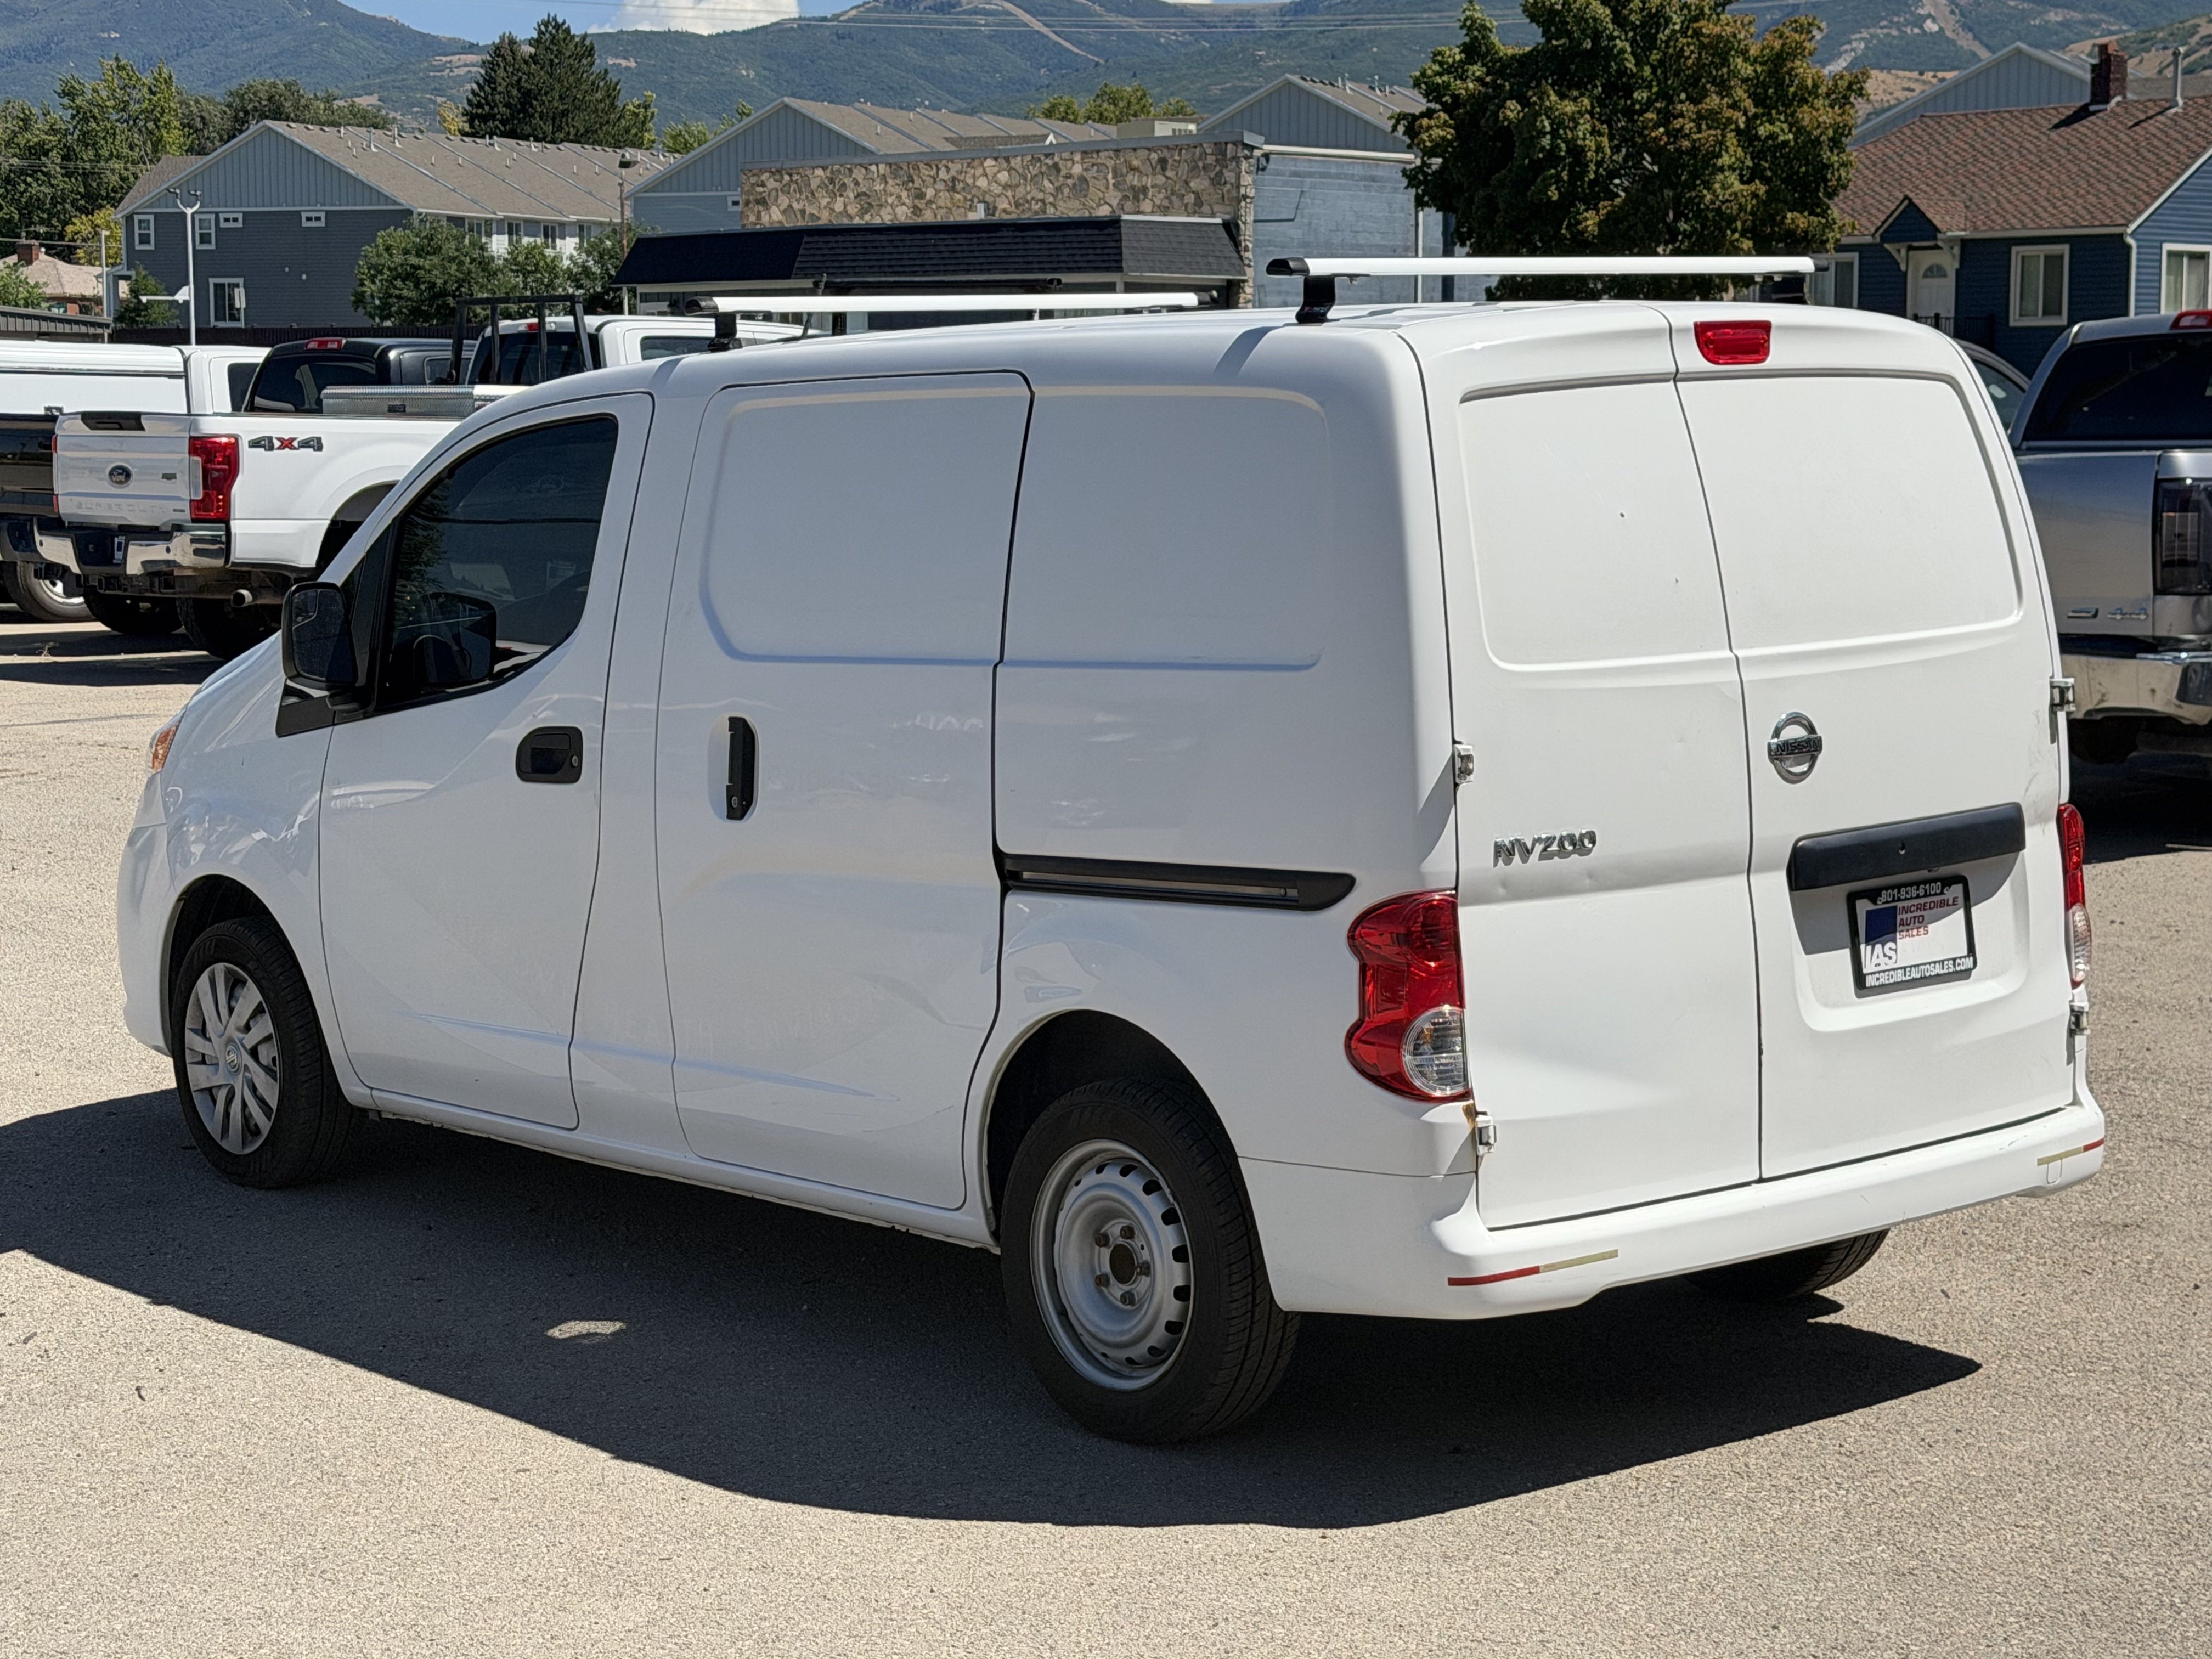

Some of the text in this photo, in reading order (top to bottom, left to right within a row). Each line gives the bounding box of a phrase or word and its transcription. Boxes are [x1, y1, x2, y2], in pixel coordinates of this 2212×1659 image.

[1775, 738, 1820, 753] NISSAN
[1493, 828, 1596, 862] NV200
[1881, 882, 1942, 902] 801-936-6100
[1898, 896, 1959, 915] INCREDIBLE
[1898, 915, 1925, 928] AUTO
[1898, 926, 1929, 940] SALES
[1866, 941, 1897, 972] IAS
[1865, 956, 1974, 988] INCREDIBLEAUTOSALES.COM
